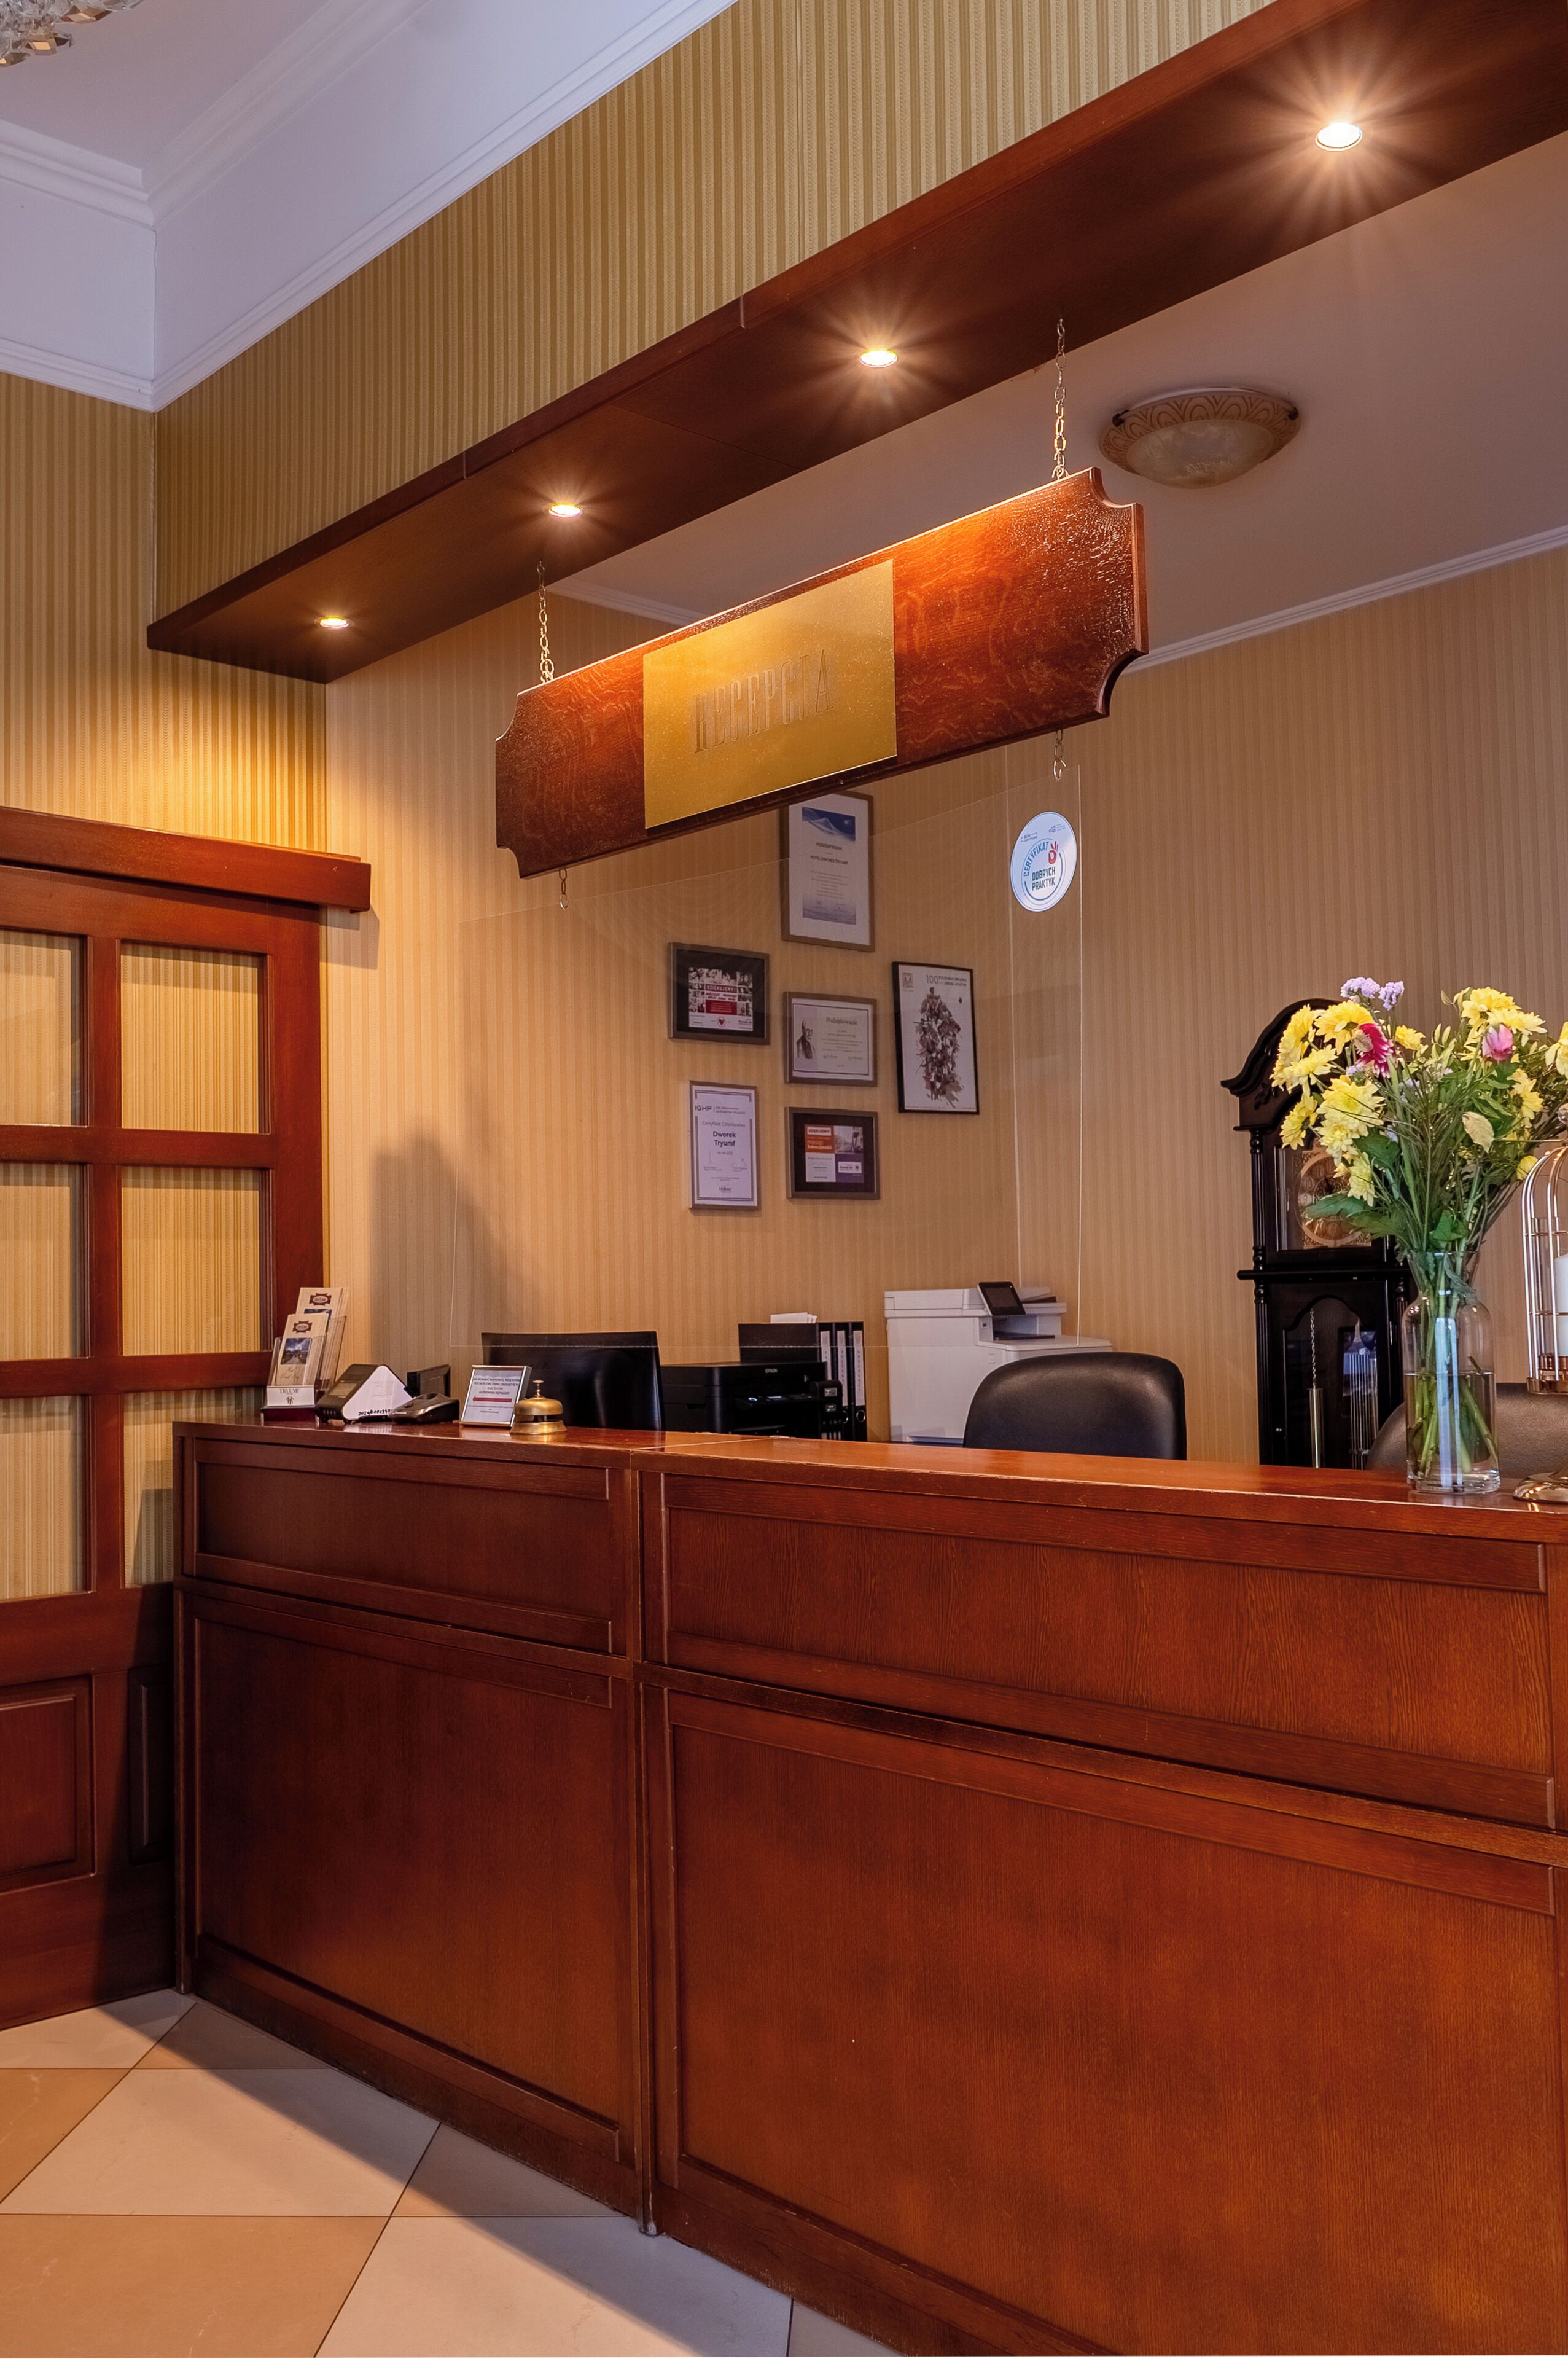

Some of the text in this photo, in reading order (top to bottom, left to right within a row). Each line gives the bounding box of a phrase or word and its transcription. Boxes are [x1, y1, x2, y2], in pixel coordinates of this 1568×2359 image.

[693, 649, 835, 753] RECEPCJA
[1023, 841, 1049, 877] CERTYFIKAT
[1032, 866, 1056, 881] DOBRYCH
[1032, 877, 1056, 891] PRAKTYK
[926, 974, 938, 984] 100
[1306, 1178, 1313, 1190] 10
[1303, 1194, 1308, 1205] 9
